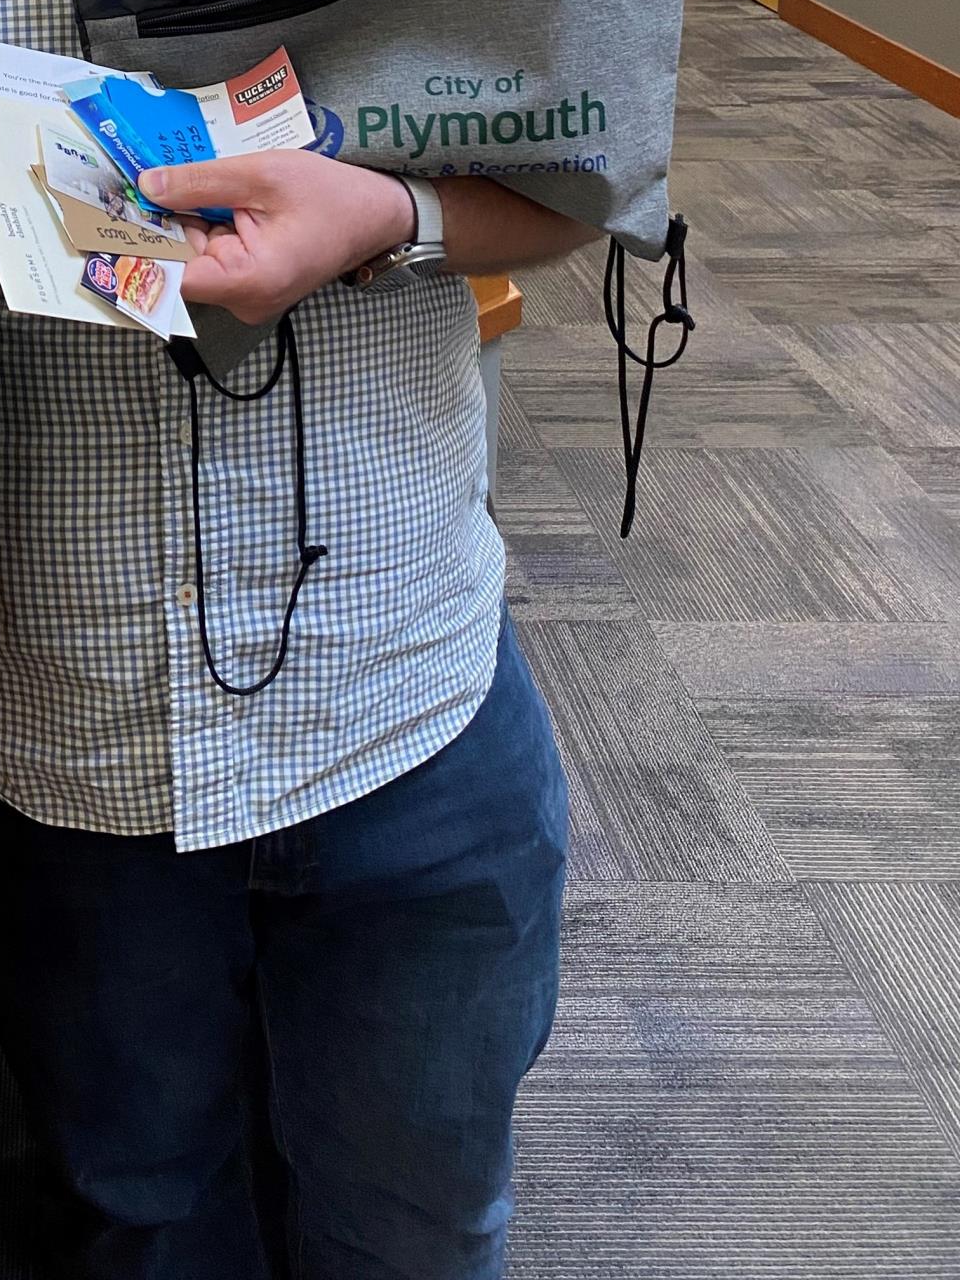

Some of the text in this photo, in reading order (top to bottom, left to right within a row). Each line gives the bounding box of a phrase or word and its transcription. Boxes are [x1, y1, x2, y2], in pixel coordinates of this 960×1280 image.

[3, 72, 27, 82] You're
[28, 77, 41, 85] the
[424, 69, 524, 99] City of
[19, 90, 38, 99] good
[39, 93, 50, 101] for
[248, 90, 274, 104] BREWING
[357, 90, 607, 159] Plymouth
[440, 163, 458, 176] &
[469, 153, 607, 176] Recreation
[0, 201, 16, 237] boundary
[10, 206, 25, 239] clothing
[97, 227, 138, 245] Tacos
[26, 253, 48, 303] FOURSOME
